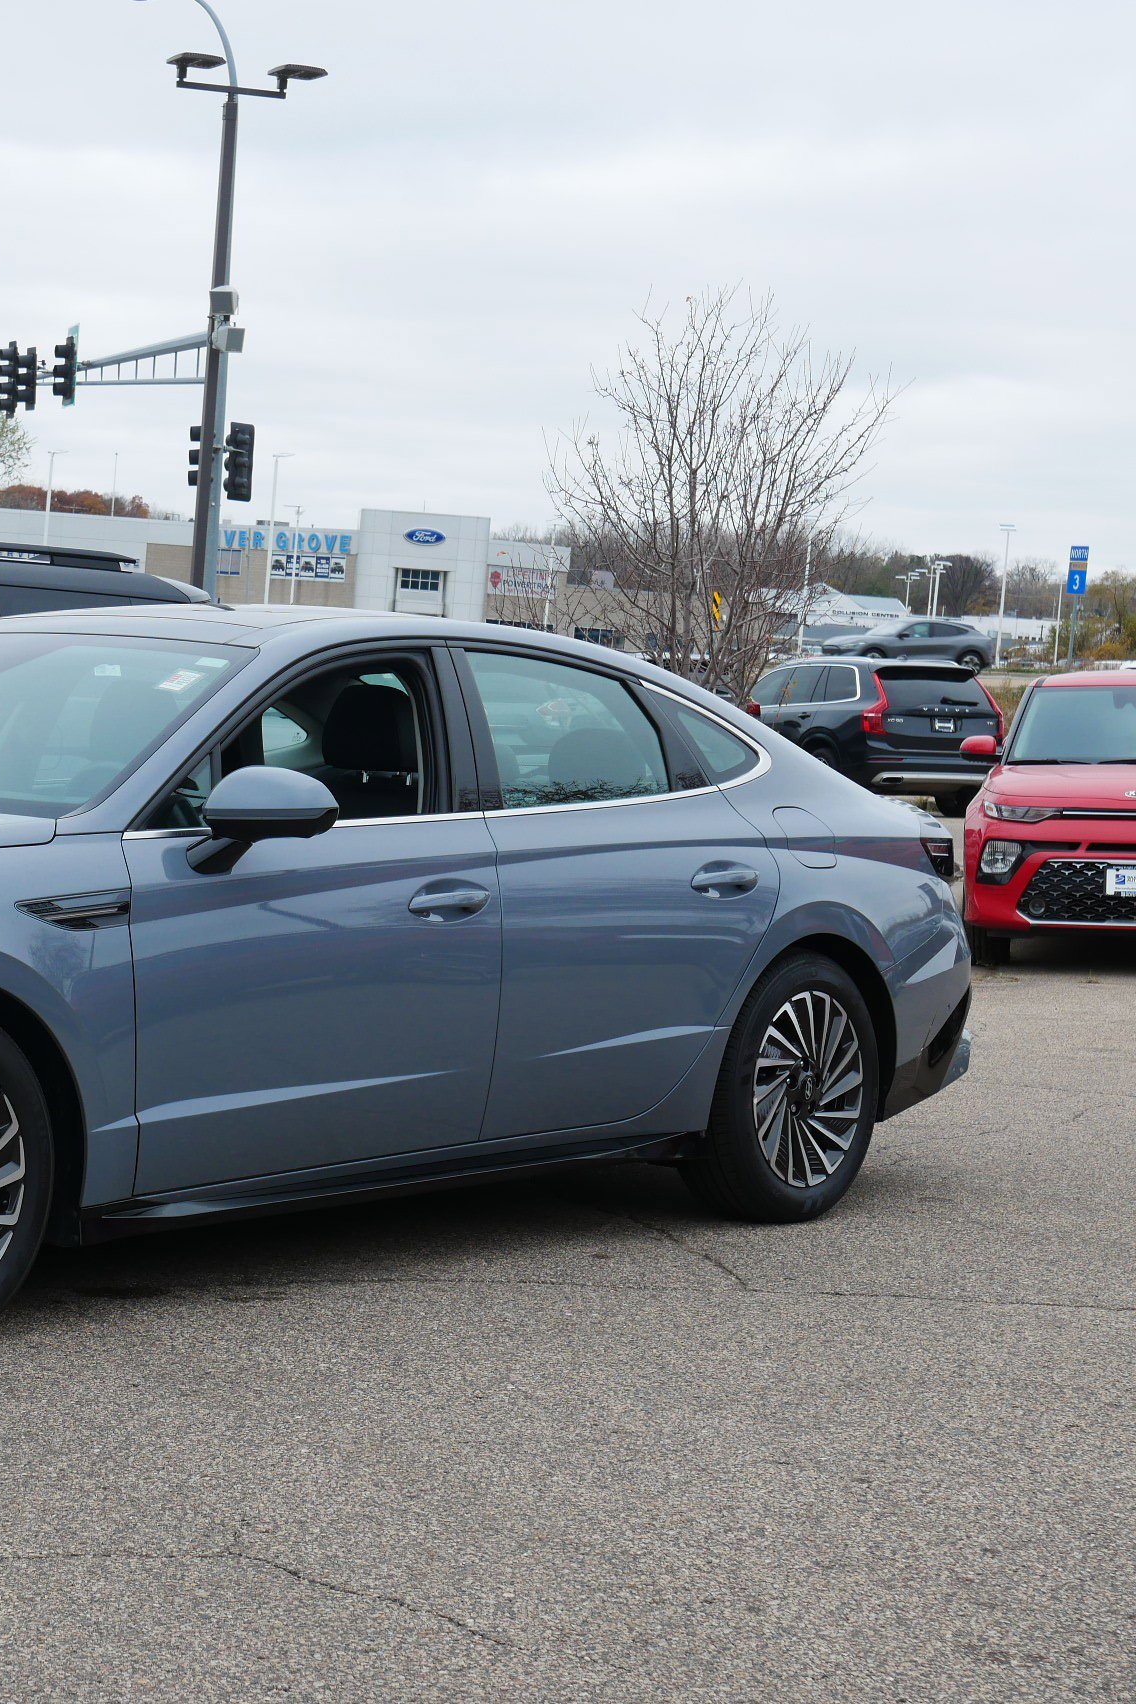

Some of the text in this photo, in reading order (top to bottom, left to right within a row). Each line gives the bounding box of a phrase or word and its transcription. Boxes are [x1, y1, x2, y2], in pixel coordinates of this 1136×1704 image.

[224, 529, 352, 553] VER GROVE
[412, 530, 437, 543] Ford
[1070, 548, 1089, 559] NORTH
[1072, 574, 1080, 590] 3
[832, 609, 869, 617] COLLISION
